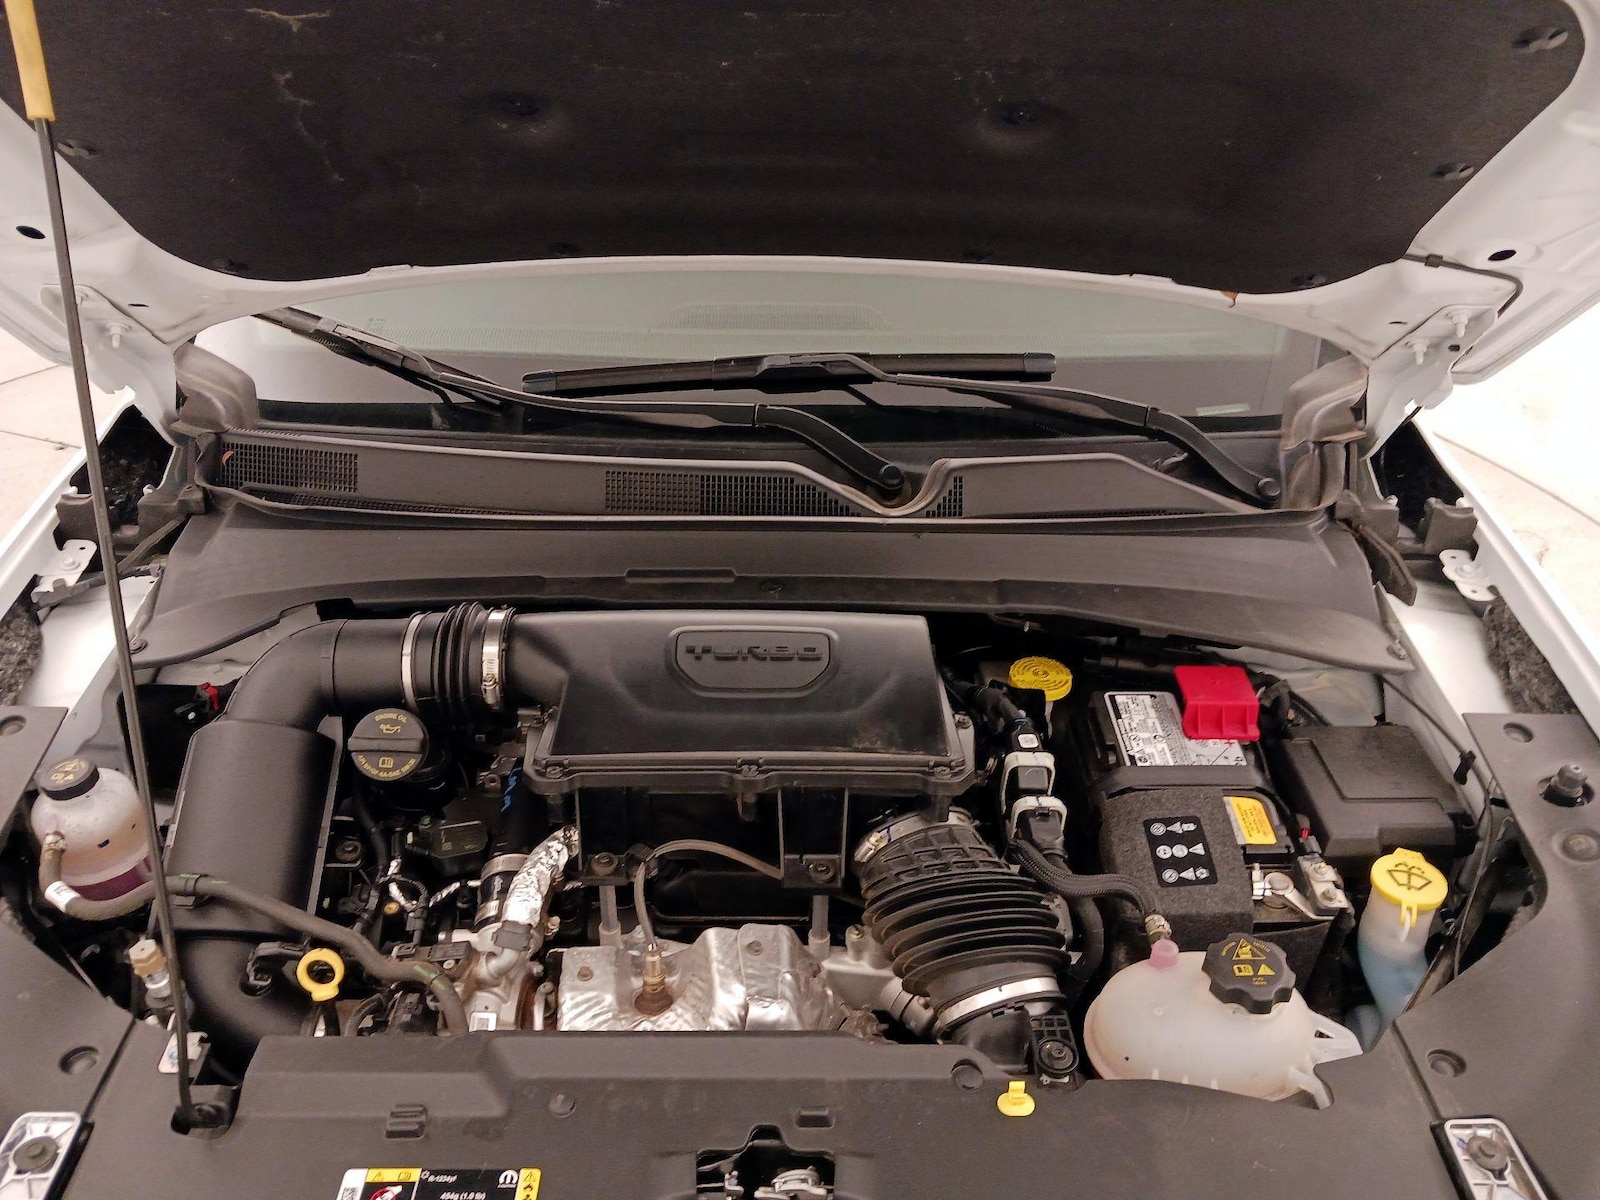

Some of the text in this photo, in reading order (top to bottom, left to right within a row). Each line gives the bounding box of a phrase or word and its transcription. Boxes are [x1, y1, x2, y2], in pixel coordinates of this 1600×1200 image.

[685, 645, 823, 662] TURBO
[375, 713, 407, 723] ENGINE OIL
